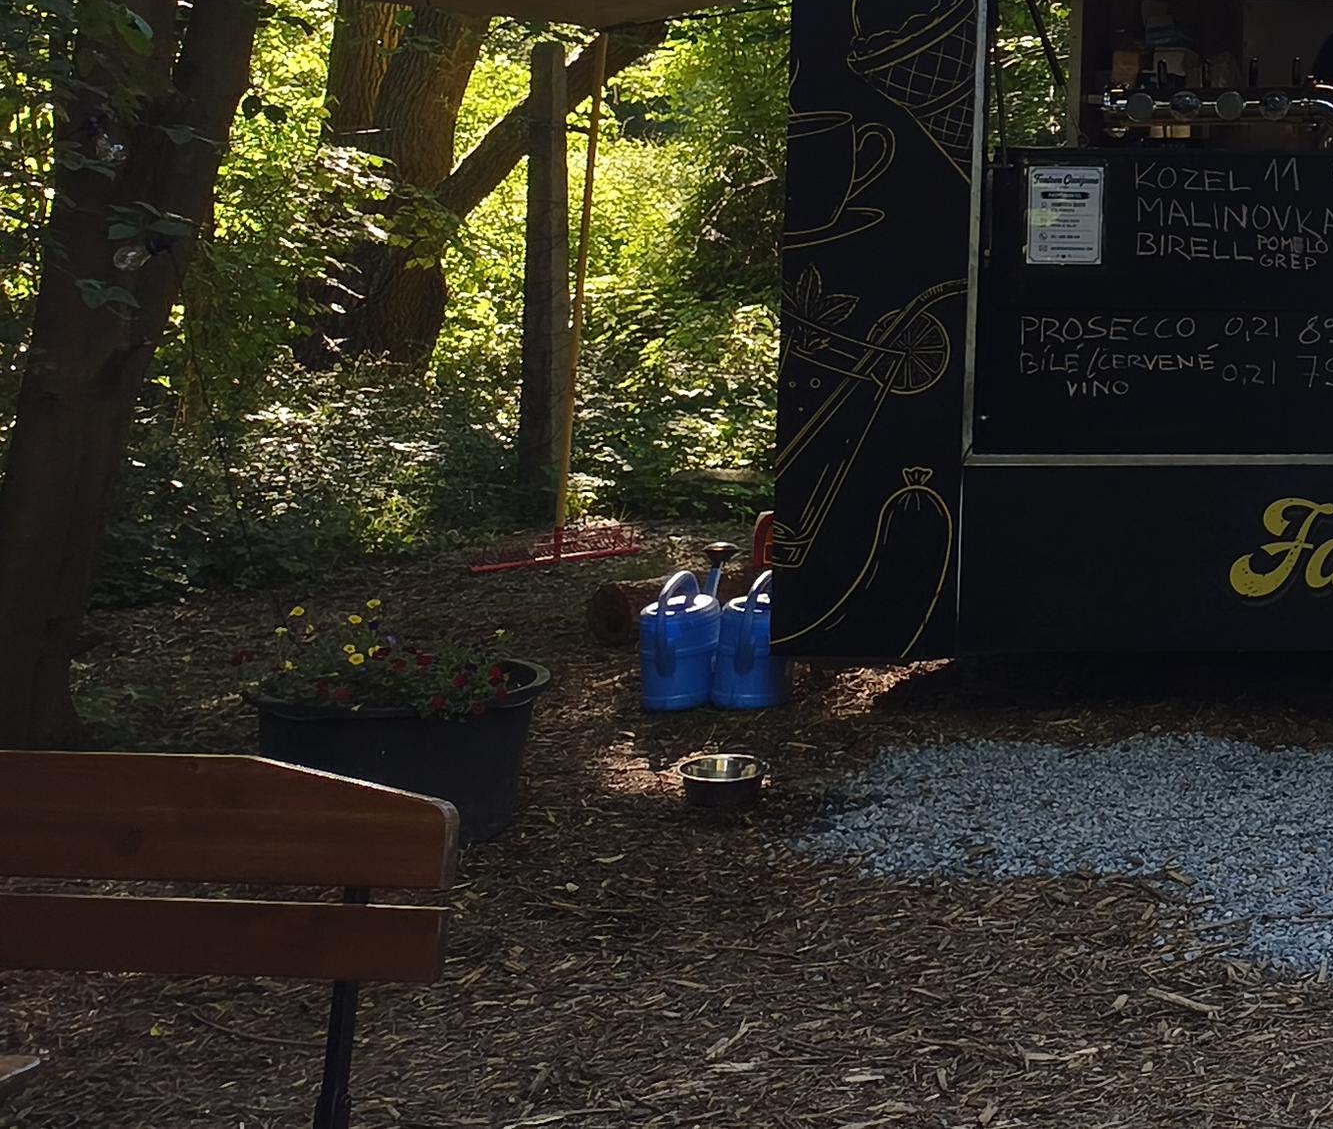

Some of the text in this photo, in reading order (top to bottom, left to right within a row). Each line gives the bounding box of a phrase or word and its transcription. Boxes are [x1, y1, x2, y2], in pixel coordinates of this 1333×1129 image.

[1134, 161, 1252, 191] KOZEL
[1264, 157, 1300, 191] 11
[1136, 231, 1329, 262] BIRELL POMELO
[1259, 253, 1317, 270] GREP
[1019, 315, 1196, 345] PROSECCO
